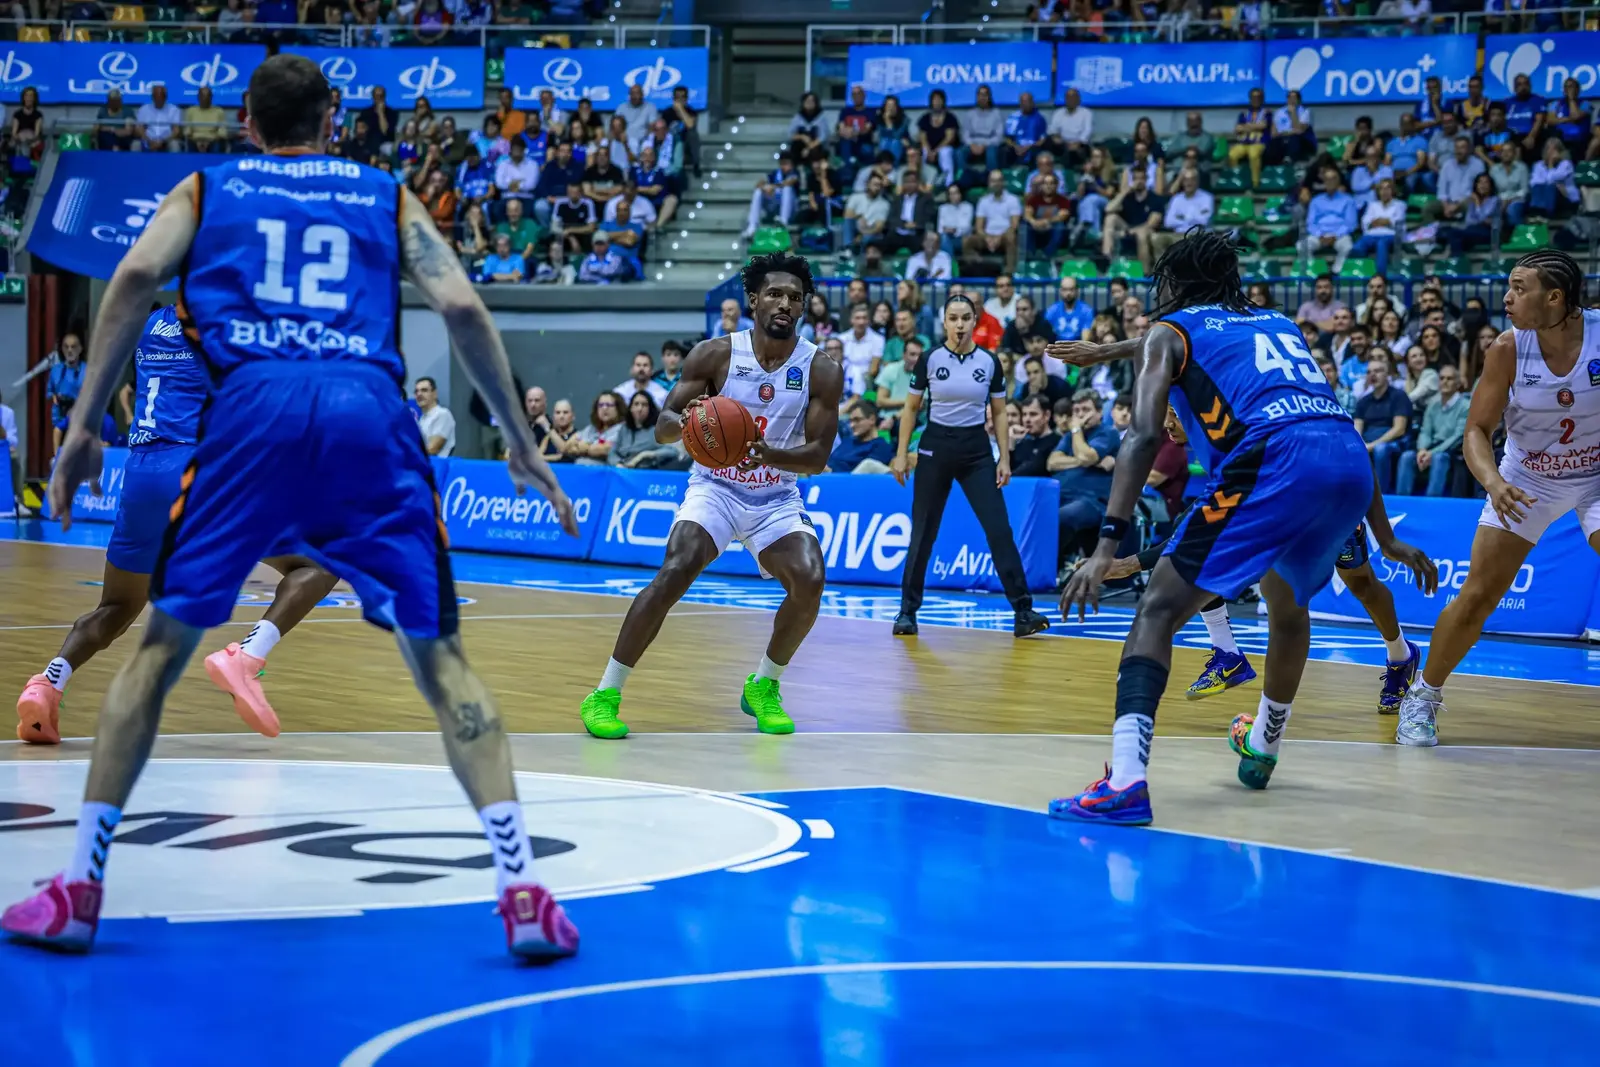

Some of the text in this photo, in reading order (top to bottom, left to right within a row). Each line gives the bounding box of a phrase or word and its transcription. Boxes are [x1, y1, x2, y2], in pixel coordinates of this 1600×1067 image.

[254, 218, 350, 311] 12
[228, 317, 369, 357] BURGOS
[1255, 332, 1327, 385] 45
[138, 376, 160, 429] 1
[1262, 394, 1354, 421] BURGO
[1559, 418, 1576, 445] 2
[933, 554, 950, 581] by
